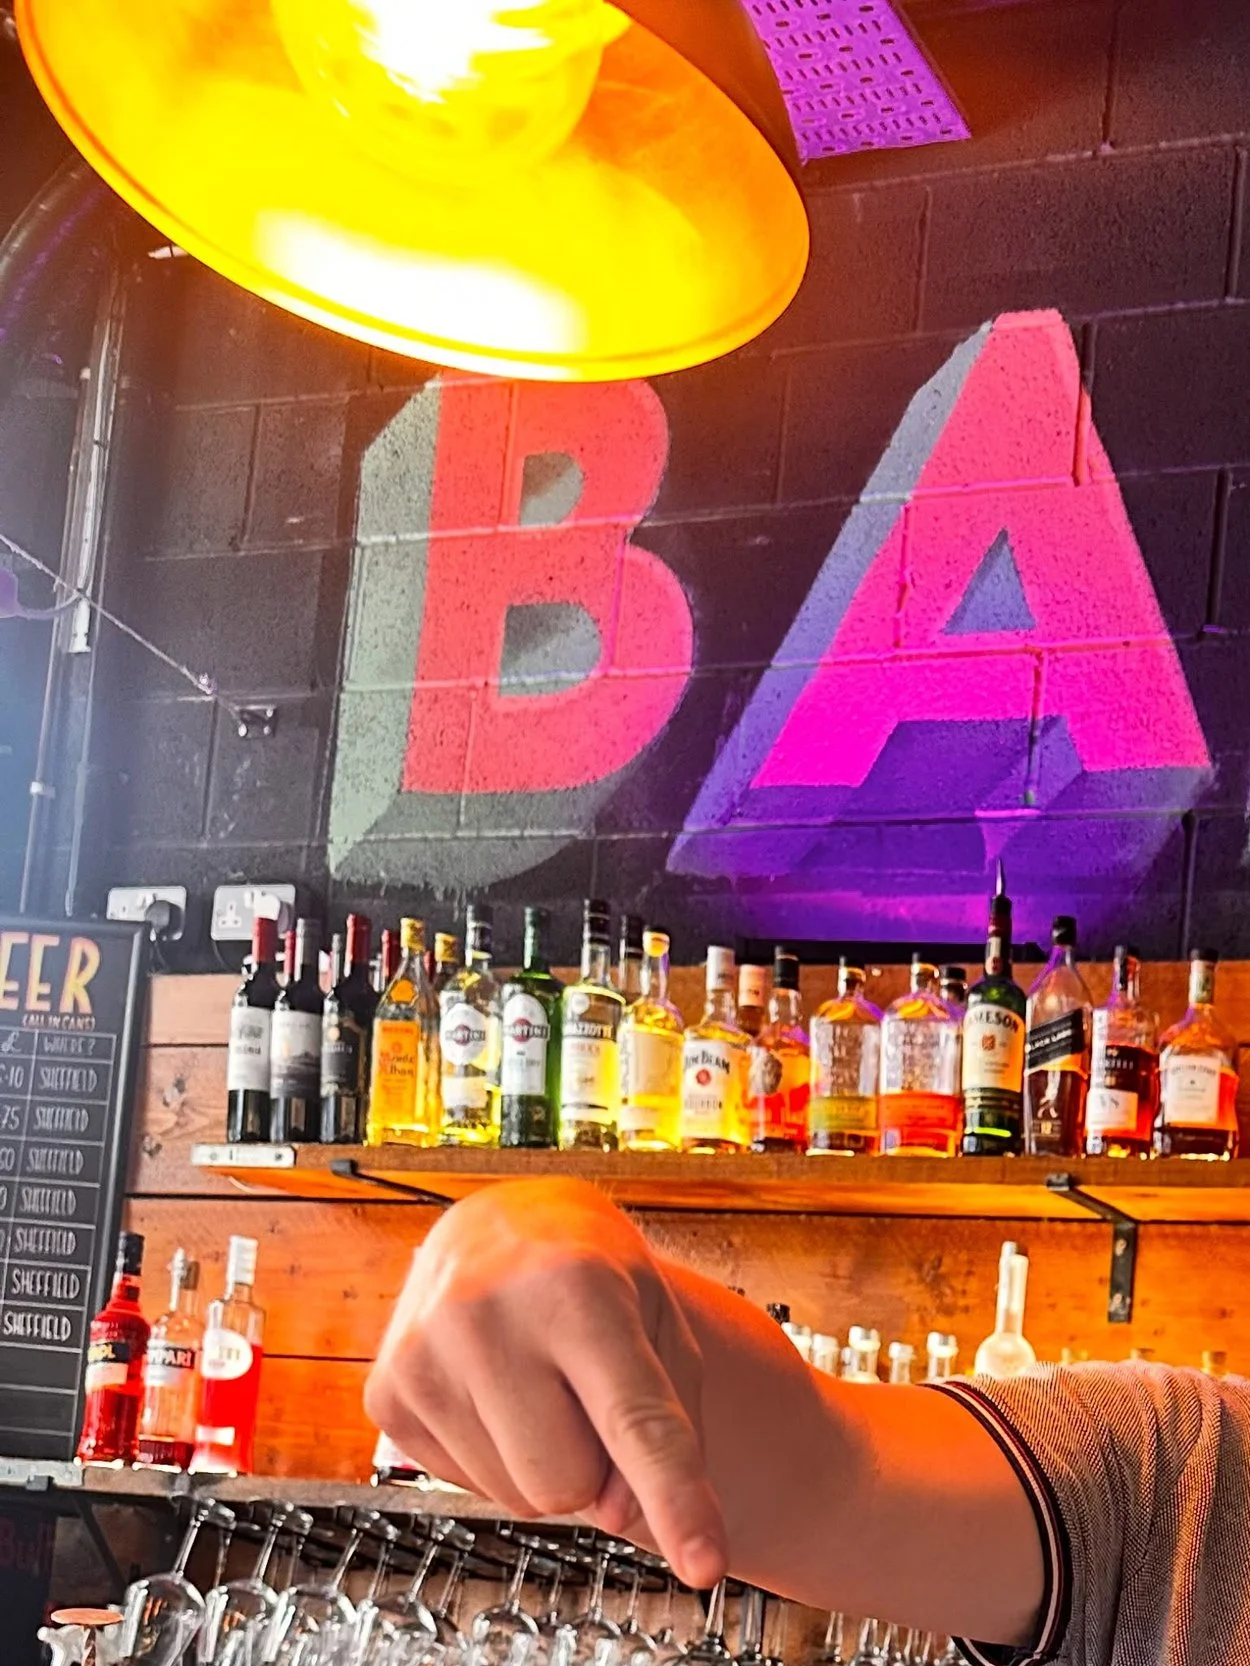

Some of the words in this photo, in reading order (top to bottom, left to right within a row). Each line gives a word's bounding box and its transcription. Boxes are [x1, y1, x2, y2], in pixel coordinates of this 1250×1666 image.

[21, 1186, 77, 1216] SHEFFIELD
[14, 1227, 77, 1256] SHEFFIELD
[11, 1268, 80, 1299] SHEFFIELD
[3, 1311, 72, 1342] SHEFFIELD
[147, 1348, 194, 1369] MPARI
